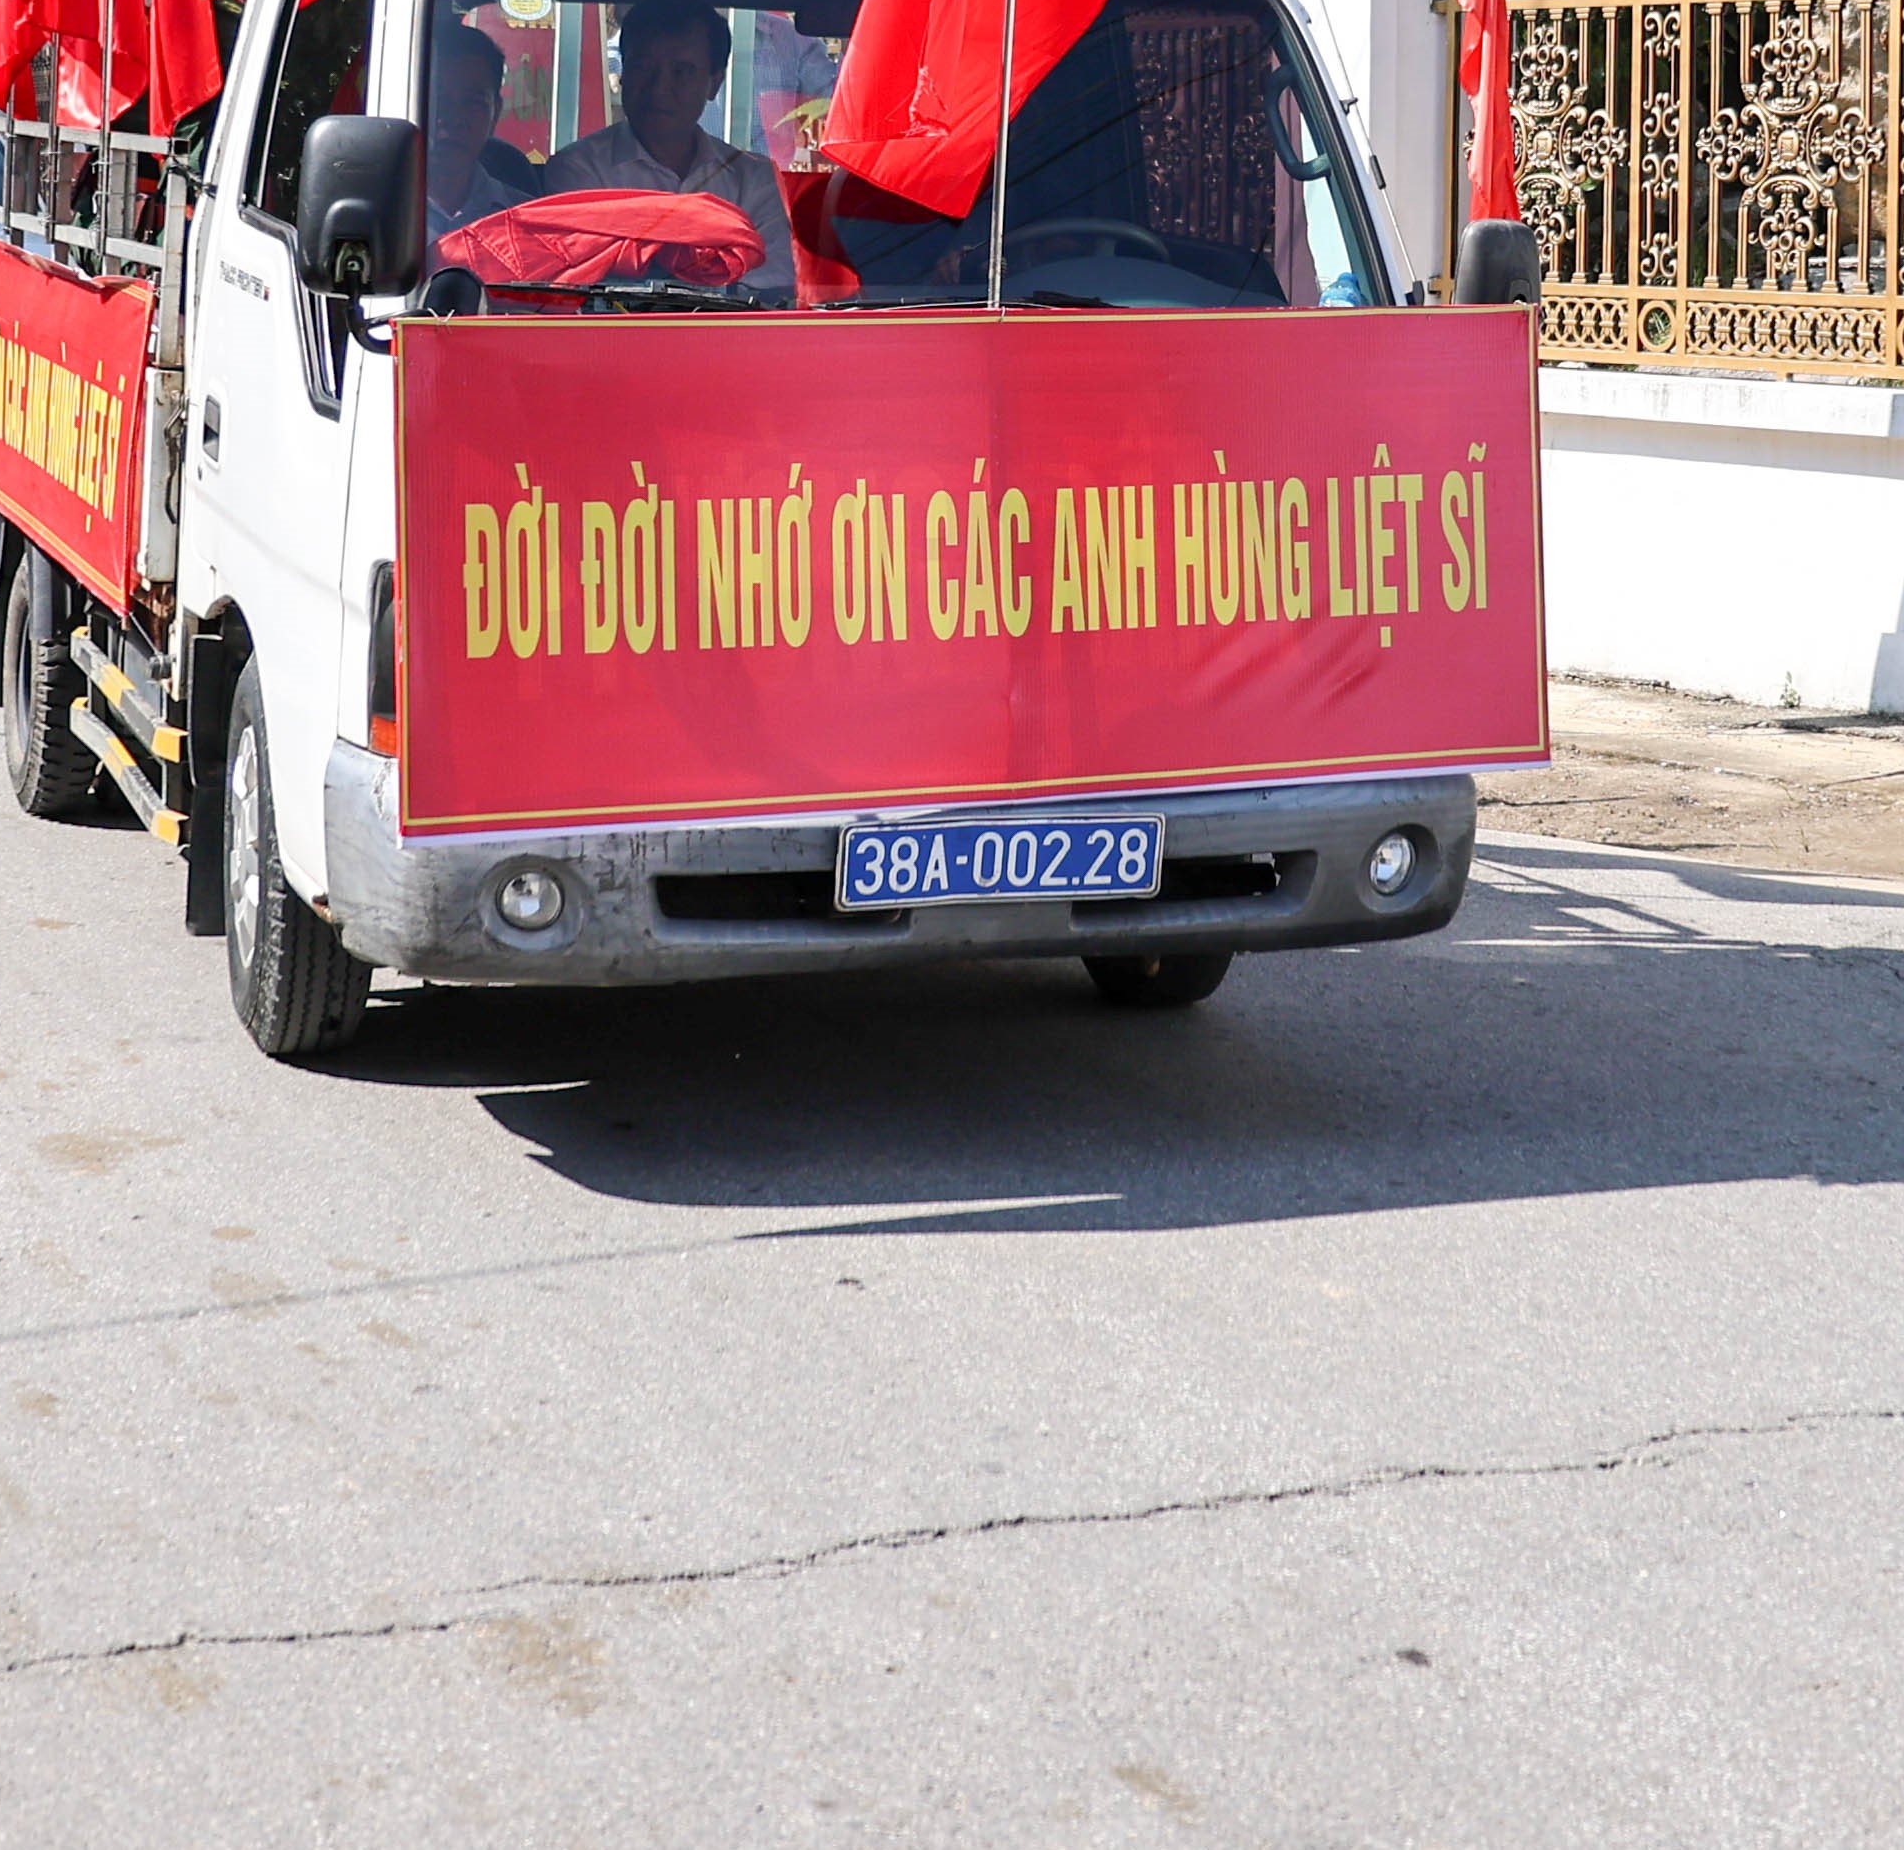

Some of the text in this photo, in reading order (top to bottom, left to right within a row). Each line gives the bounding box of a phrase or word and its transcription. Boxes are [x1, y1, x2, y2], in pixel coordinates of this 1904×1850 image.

[463, 441, 1489, 659] ĐỜI ĐỜI NHỚ ƠN CÁC ANH HÙNG LIỆT SĨ
[853, 830, 1148, 896] 38A-002.28
